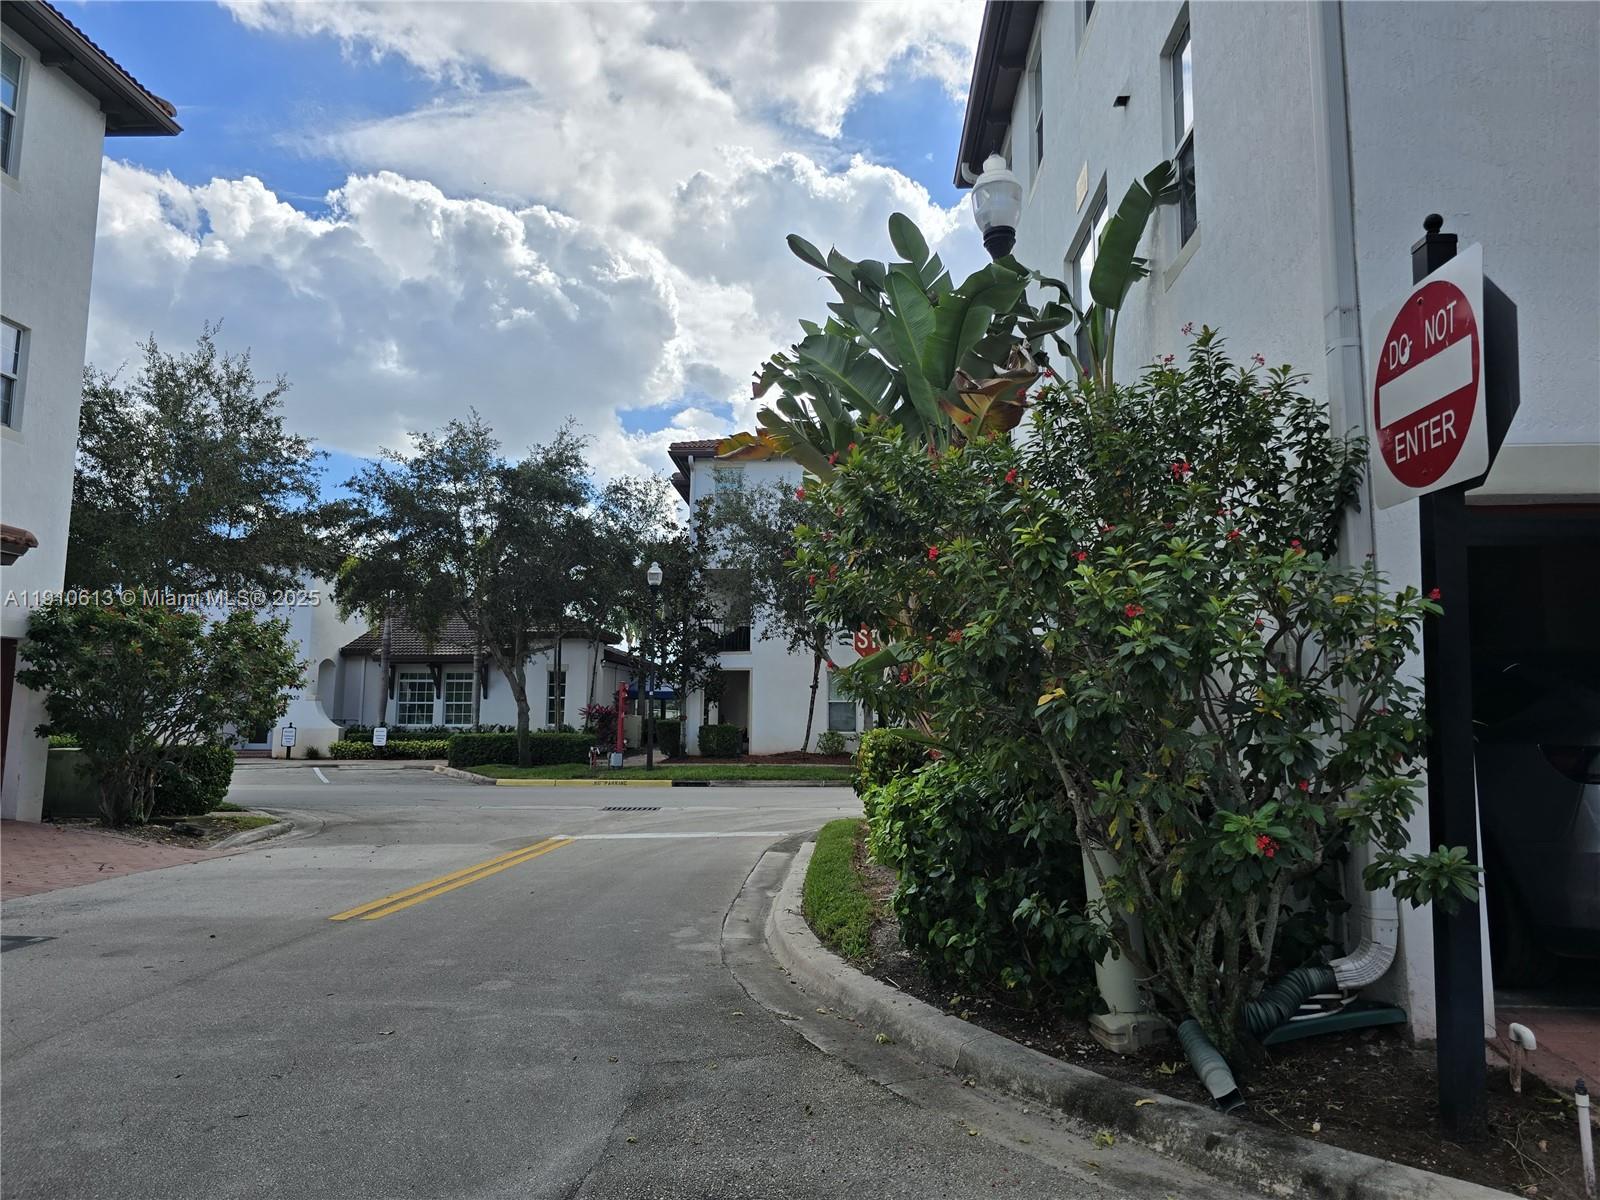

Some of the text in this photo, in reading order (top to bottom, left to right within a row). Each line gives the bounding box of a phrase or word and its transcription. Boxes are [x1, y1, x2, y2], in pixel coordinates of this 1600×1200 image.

[1389, 300, 1457, 370] DO NOT
[1394, 409, 1457, 464] ENTER
[857, 629, 882, 649] ST
